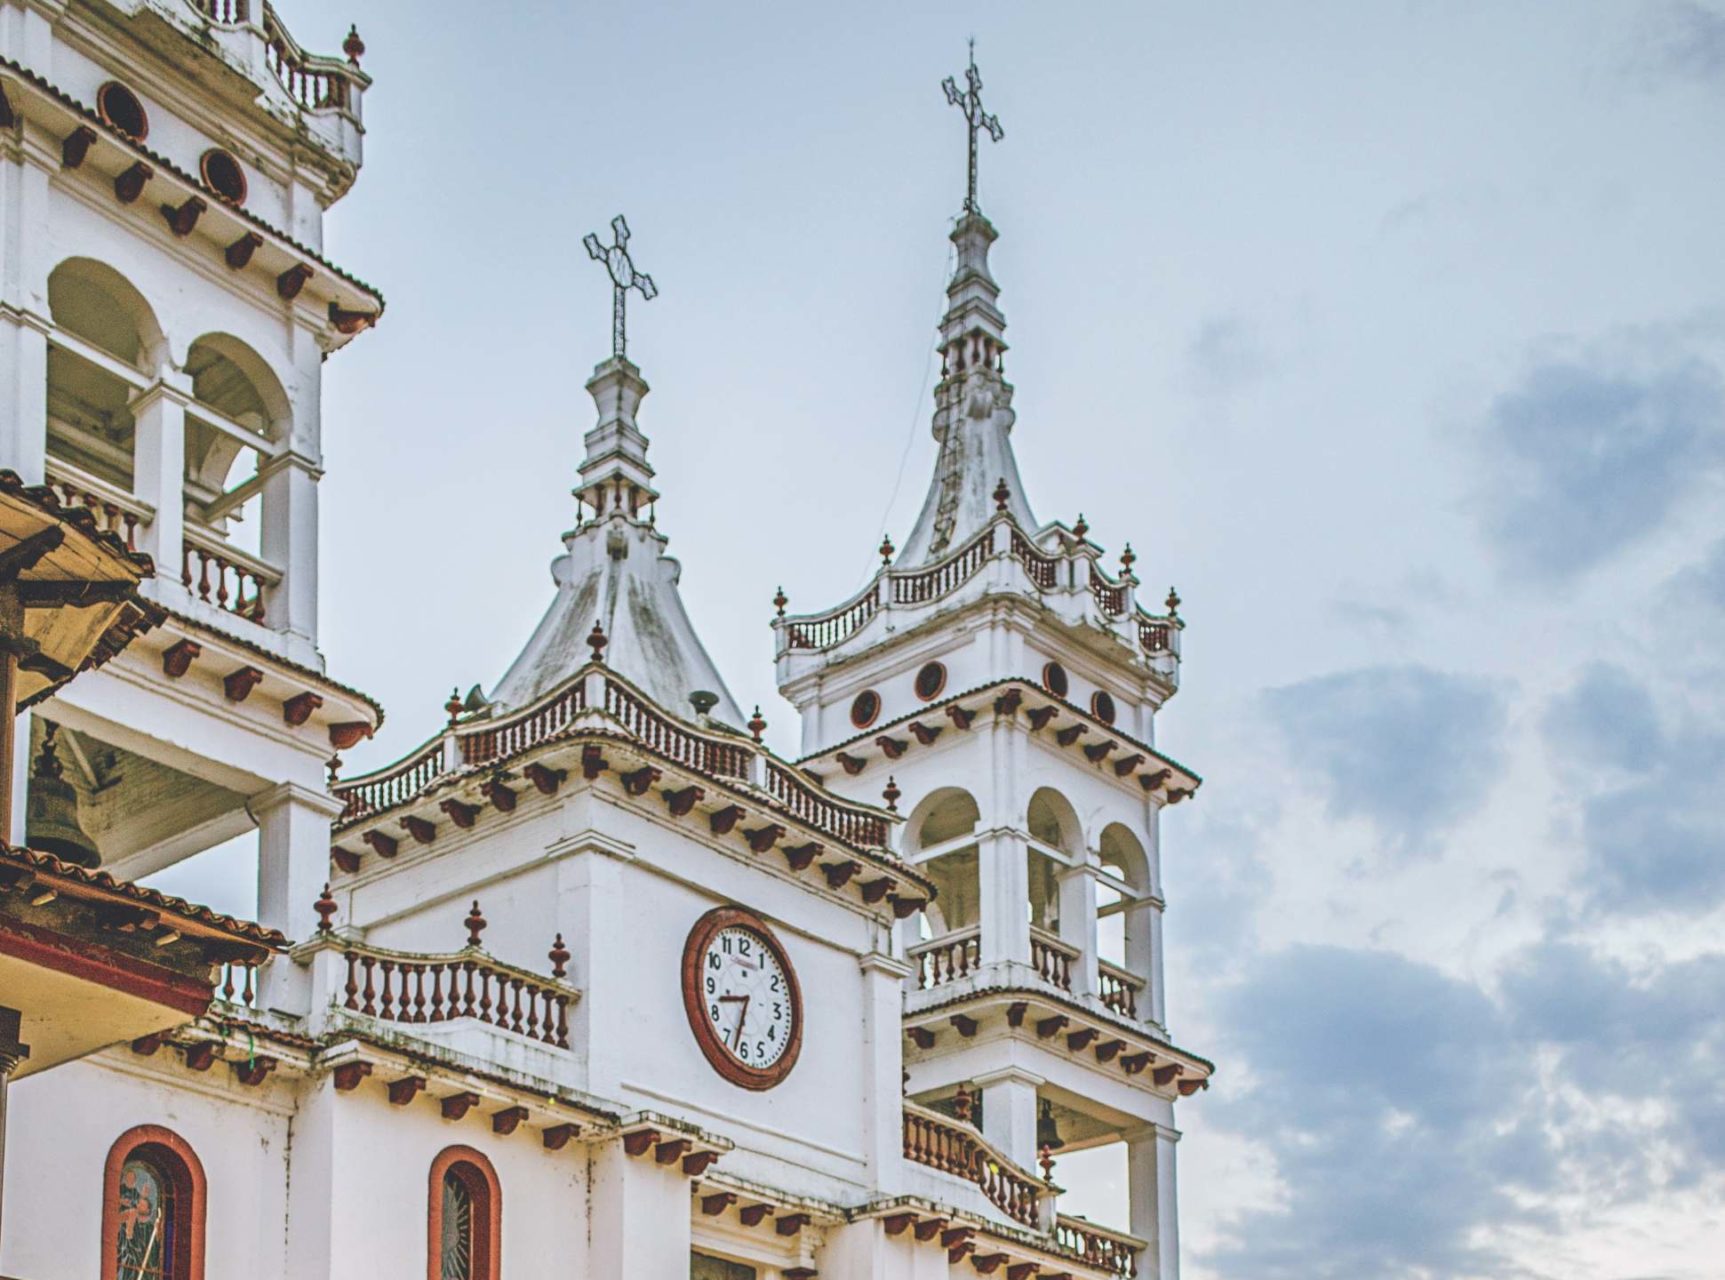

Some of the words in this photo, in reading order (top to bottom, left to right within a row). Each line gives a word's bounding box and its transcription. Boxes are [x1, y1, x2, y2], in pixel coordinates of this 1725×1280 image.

[722, 936, 731, 955] 11
[738, 938, 750, 957] 12
[709, 952, 721, 970] 10
[759, 953, 764, 969] 1
[707, 977, 715, 994] 9
[771, 975, 779, 992] 2
[712, 1005, 719, 1021] 8
[774, 1003, 781, 1020] 3
[723, 1028, 731, 1046] 7
[767, 1025, 775, 1042] 4
[741, 1042, 748, 1059] 6
[757, 1042, 765, 1058] 5
